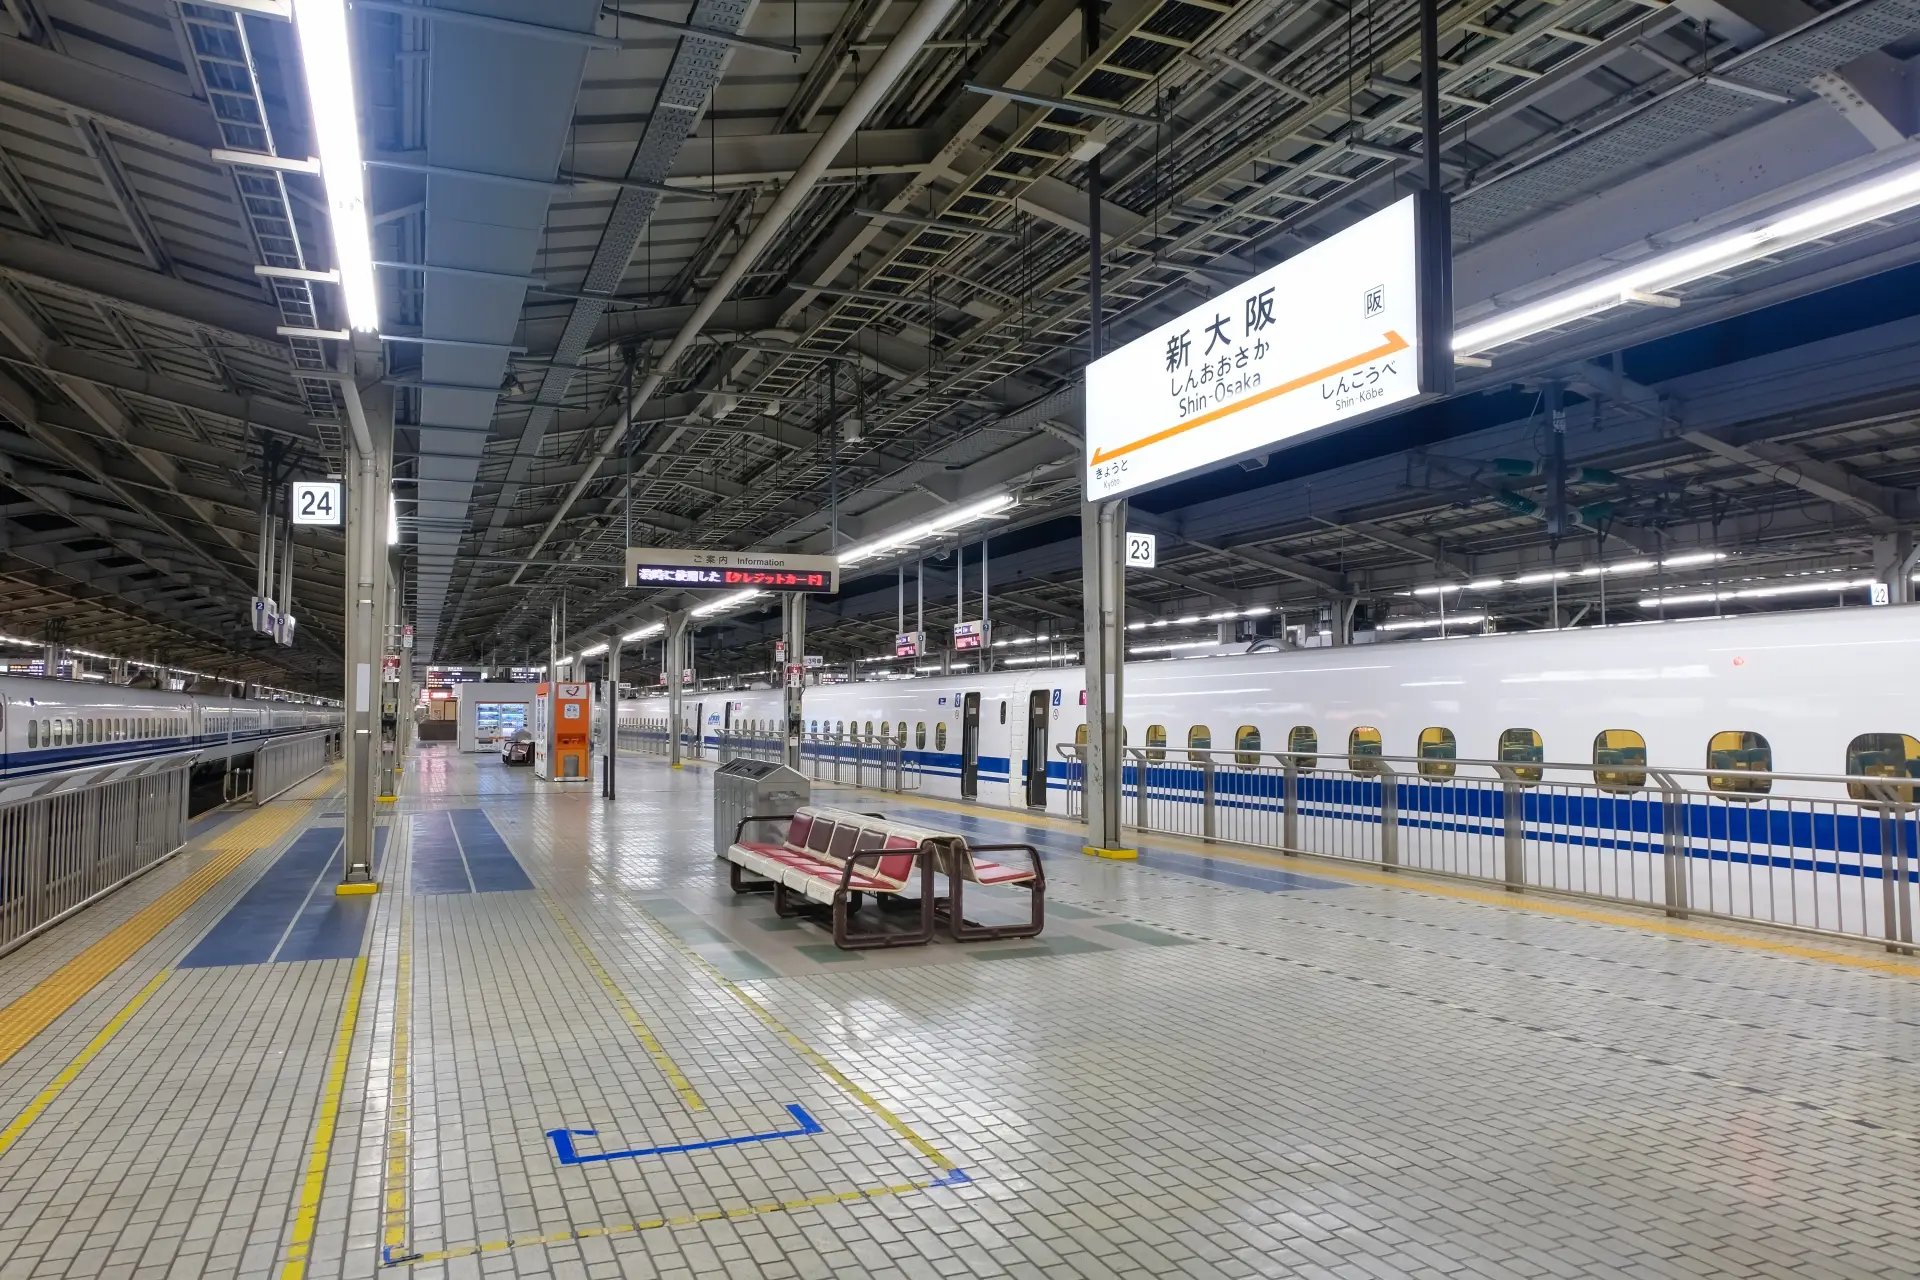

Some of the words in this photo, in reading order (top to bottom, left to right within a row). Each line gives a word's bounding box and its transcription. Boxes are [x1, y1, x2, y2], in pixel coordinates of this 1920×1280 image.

[1366, 289, 1383, 315] 阪
[1166, 286, 1276, 373] 新大阪
[1171, 338, 1270, 397] しんおおさか
[1321, 360, 1398, 400] しんこうべ
[1179, 372, 1262, 418] Shin-Ōsaka
[1335, 387, 1385, 411] Shin-Kōbe
[1095, 459, 1128, 480] きょうと
[301, 490, 333, 516] 24
[693, 555, 728, 565] ご案内
[737, 557, 785, 567] Information
[1130, 539, 1150, 561] 23
[1875, 587, 1886, 603] 22
[1053, 690, 1060, 705] 2
